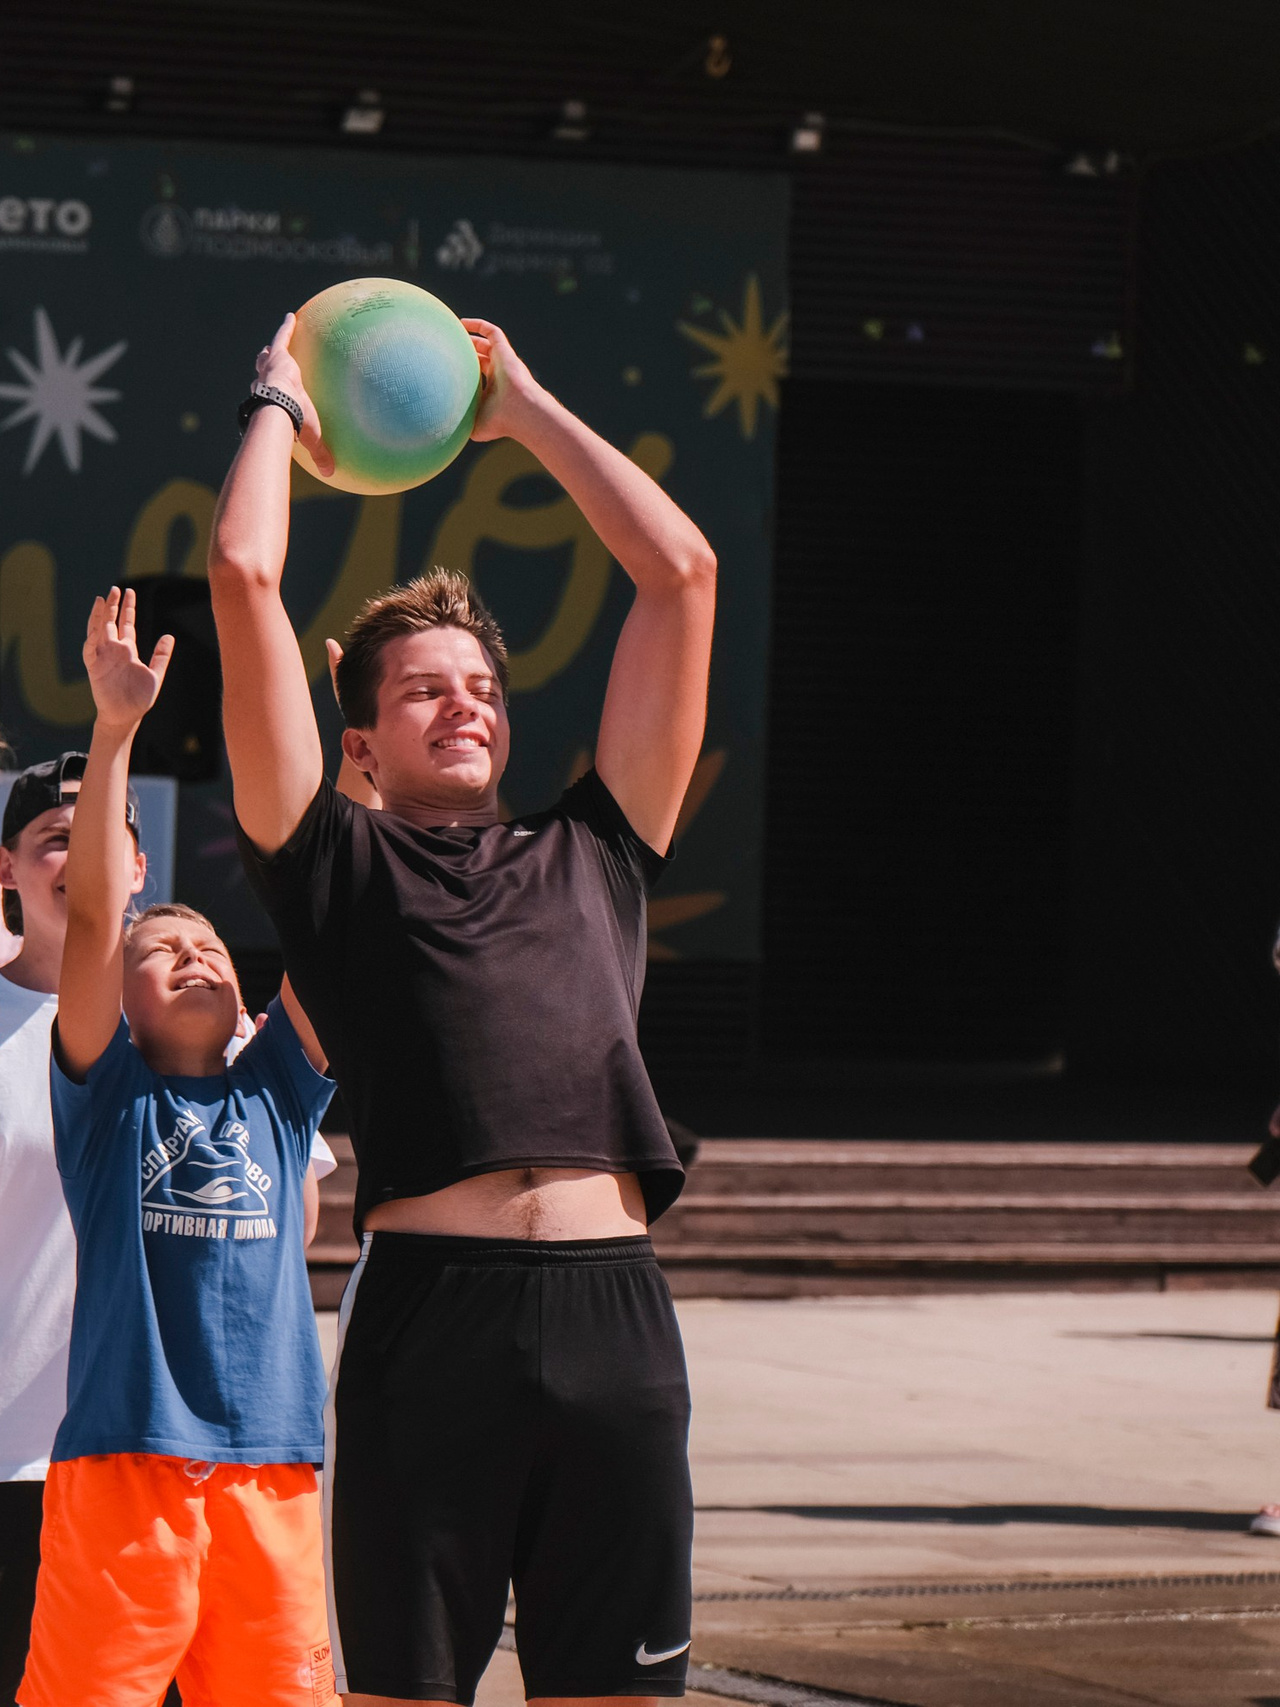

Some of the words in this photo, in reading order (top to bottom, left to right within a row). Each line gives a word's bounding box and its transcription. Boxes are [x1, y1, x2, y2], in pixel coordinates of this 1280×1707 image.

[142, 1109, 203, 1180] СПАРТАК
[141, 1210, 228, 1239] ОРТИВНАЯ
[234, 1218, 277, 1240] ШКОЛА
